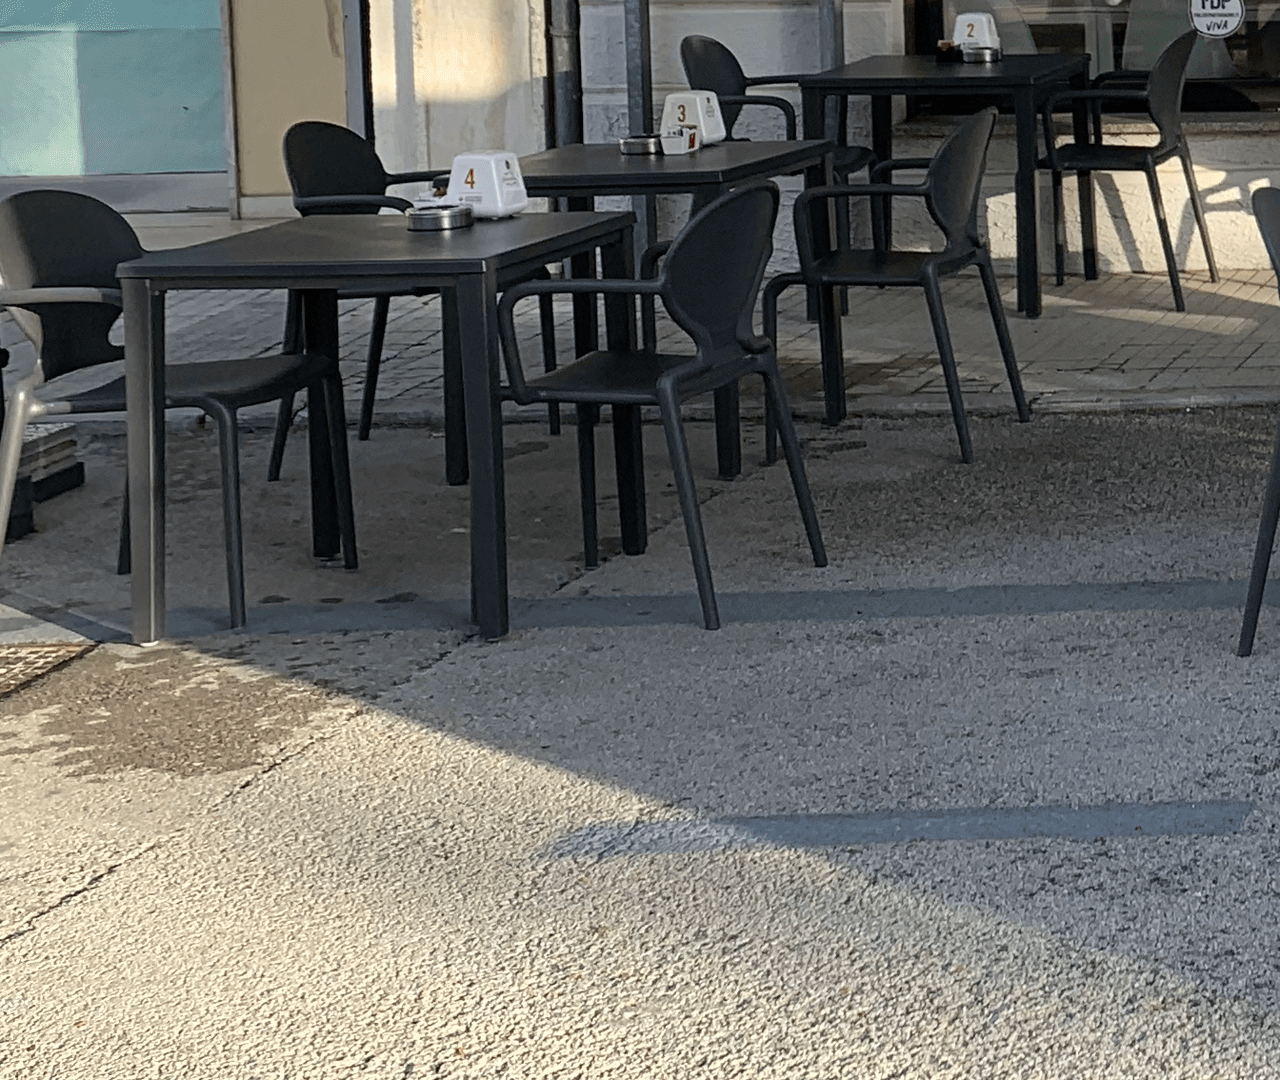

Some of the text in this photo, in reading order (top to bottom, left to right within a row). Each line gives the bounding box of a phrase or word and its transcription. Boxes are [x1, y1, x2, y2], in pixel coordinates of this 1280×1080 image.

[966, 22, 975, 38] 2
[677, 104, 686, 123] 3
[464, 167, 475, 189] 4
